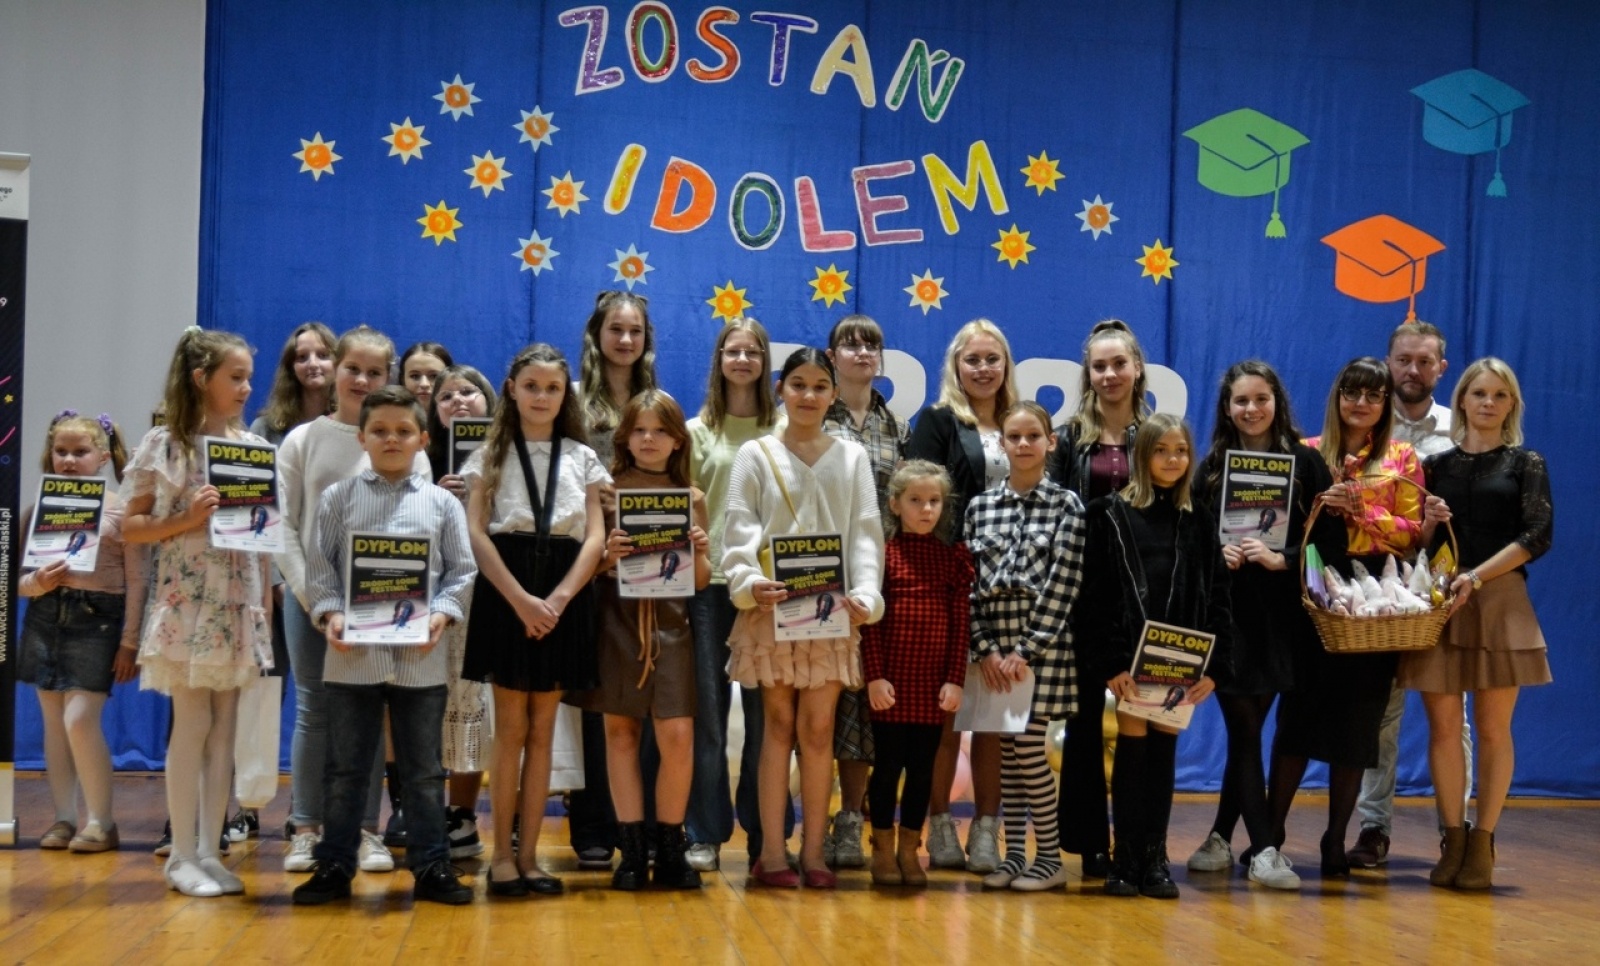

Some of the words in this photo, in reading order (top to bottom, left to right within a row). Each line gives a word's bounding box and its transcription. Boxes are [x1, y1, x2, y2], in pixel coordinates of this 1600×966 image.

[558, 0, 966, 123] ZOSTAŃ
[604, 140, 1009, 251] IDOLEM
[210, 445, 274, 464] DYPLOM
[1230, 457, 1290, 472] DYPLOM
[44, 480, 103, 495] DYPLOM
[621, 496, 688, 509] DYPLOM
[355, 539, 428, 555] DYPLOM
[775, 539, 840, 553] DYPLOM
[1147, 628, 1210, 652] DYPLOM
